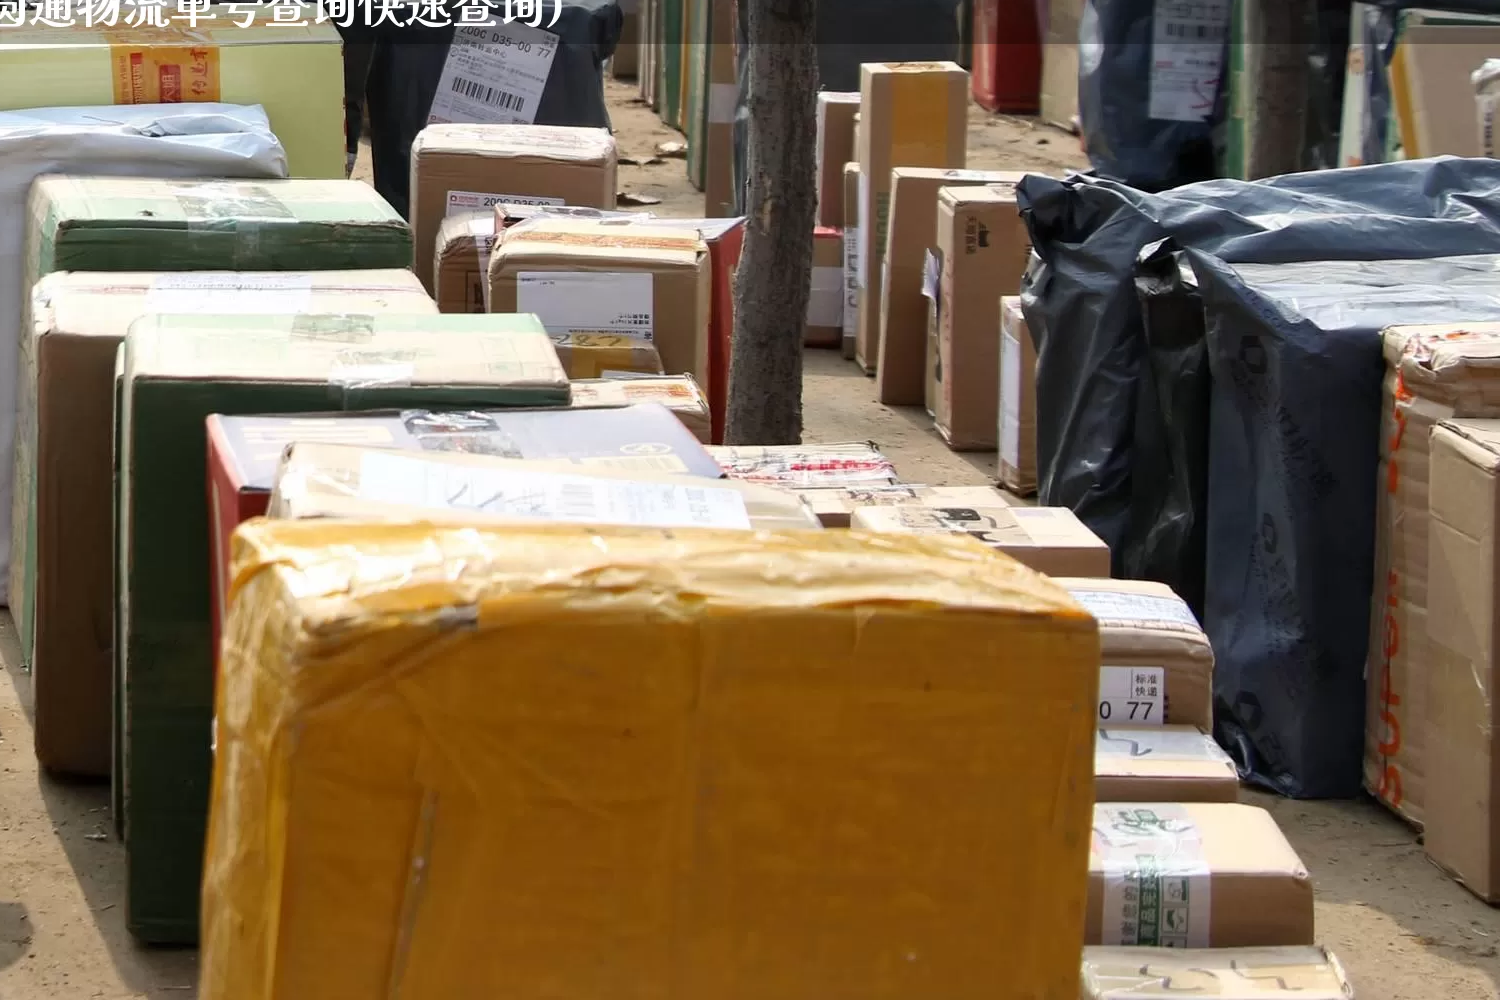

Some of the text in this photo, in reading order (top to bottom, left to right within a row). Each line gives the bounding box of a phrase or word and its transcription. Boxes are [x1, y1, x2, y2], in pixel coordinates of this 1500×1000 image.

[537, 46, 552, 59] 77
[1135, 673, 1157, 685] 标准
[1135, 686, 1158, 697] 快递
[1127, 701, 1153, 721] 77
